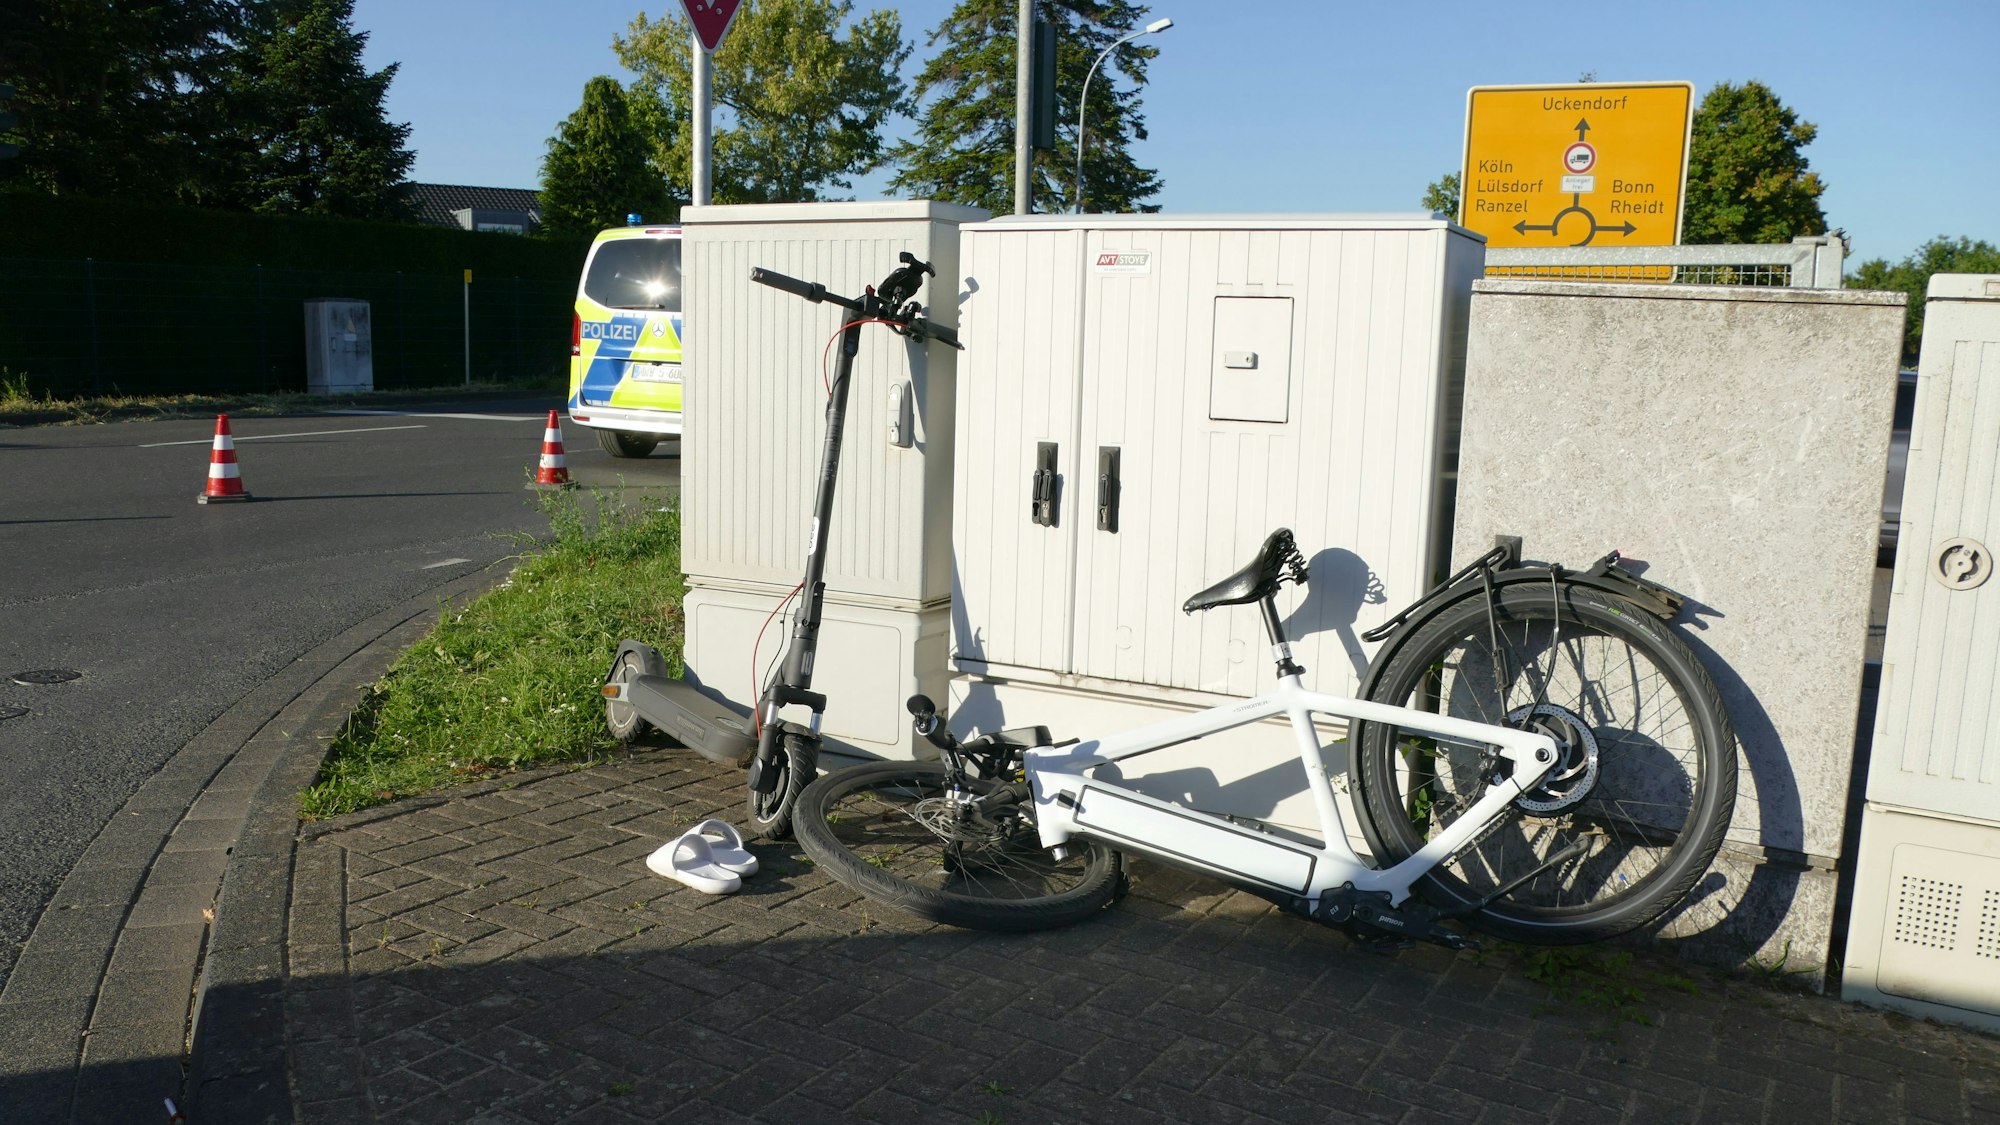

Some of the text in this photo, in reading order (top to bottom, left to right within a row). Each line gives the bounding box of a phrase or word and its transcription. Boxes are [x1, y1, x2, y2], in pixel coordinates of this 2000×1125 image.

[1543, 96, 1628, 111] Uckendorf
[1479, 160, 1513, 173] Köln
[1477, 179, 1544, 193] Lülsdorf
[1612, 179, 1654, 194] Bonn
[1475, 199, 1528, 213] Ranzel
[1610, 200, 1664, 214] Rheidt
[1099, 255, 1145, 264] AVT STOYE
[582, 323, 637, 340] POLIZEI
[1379, 915, 1404, 927] pinion
